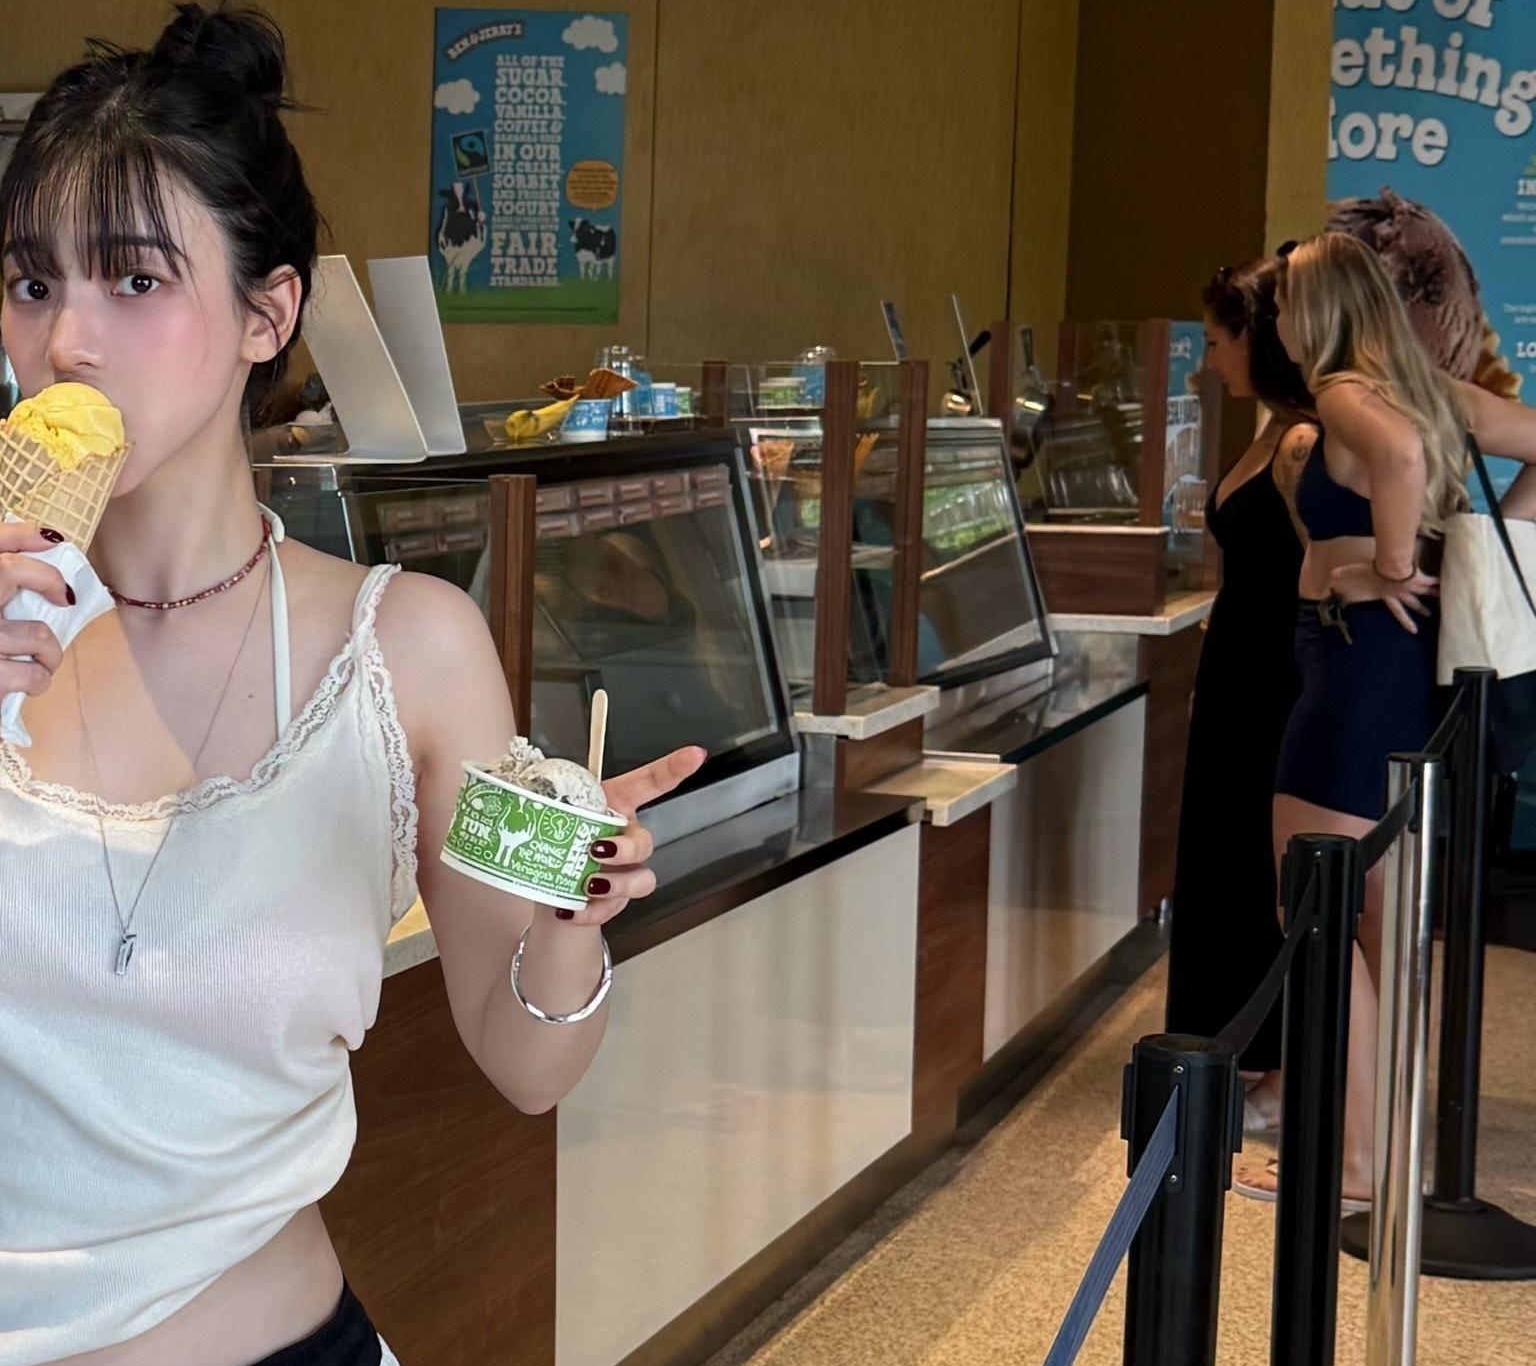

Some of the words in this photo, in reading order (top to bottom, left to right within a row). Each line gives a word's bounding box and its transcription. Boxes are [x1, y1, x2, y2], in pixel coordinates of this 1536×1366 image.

[496, 54, 519, 67] ALL
[520, 55, 537, 67] OF
[539, 55, 565, 68] THE
[494, 120, 549, 133] COFFEE
[1328, 95, 1448, 166] ore
[493, 143, 516, 161] IN
[520, 143, 561, 161] OUR
[493, 161, 515, 173] ICE
[492, 174, 561, 189] SORBET
[492, 200, 560, 216] YOGURT
[491, 231, 560, 256] FAIR
[490, 257, 558, 276] TRADE
